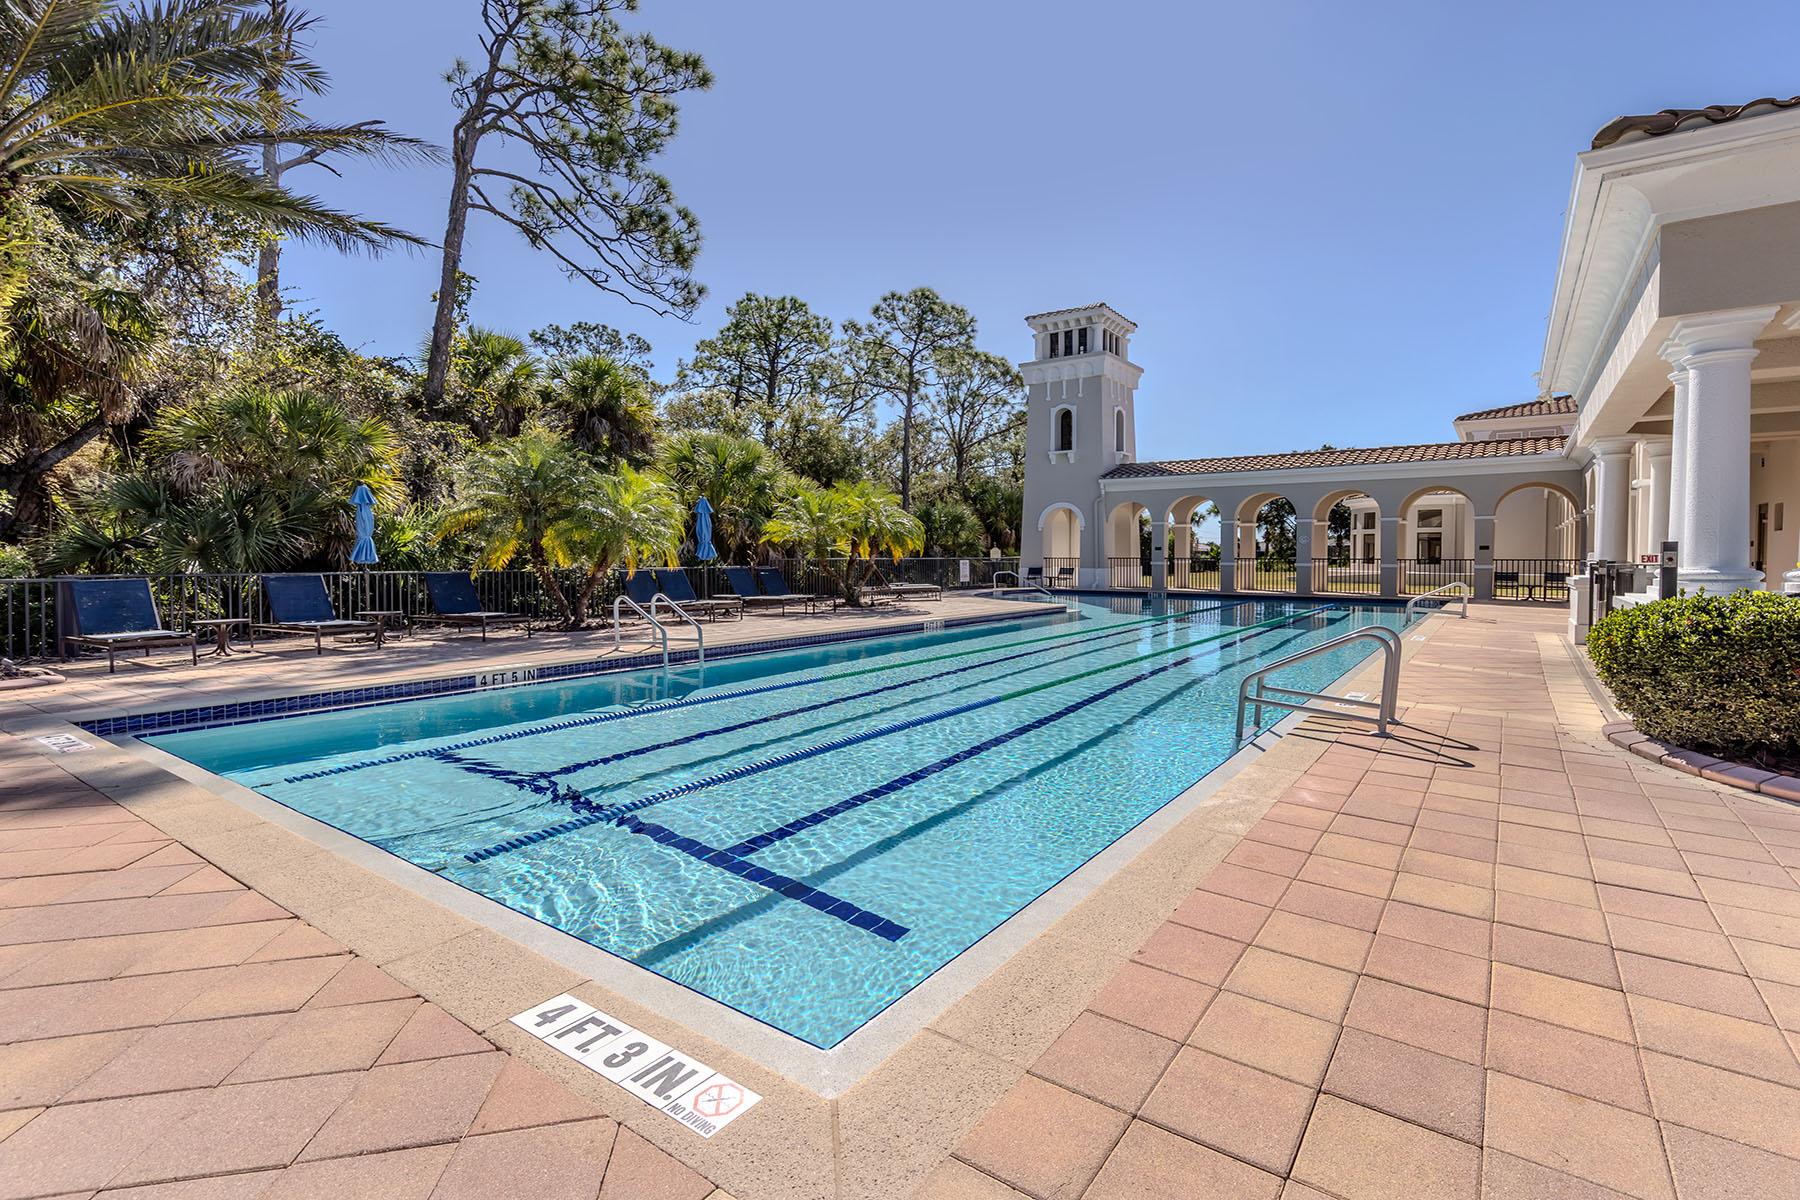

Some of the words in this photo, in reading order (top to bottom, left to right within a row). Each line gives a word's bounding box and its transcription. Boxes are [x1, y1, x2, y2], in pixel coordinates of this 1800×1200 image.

[1641, 555, 1659, 563] EXIT
[480, 675, 488, 686] 4
[492, 673, 506, 685] FT
[511, 672, 518, 682] 5
[523, 669, 536, 681] IN
[534, 1004, 578, 1028] 4
[554, 1016, 623, 1054] FT.
[602, 1041, 649, 1069] 3
[630, 1055, 699, 1101] IN.
[667, 1102, 683, 1116] NO
[680, 1111, 717, 1136] DIVING
